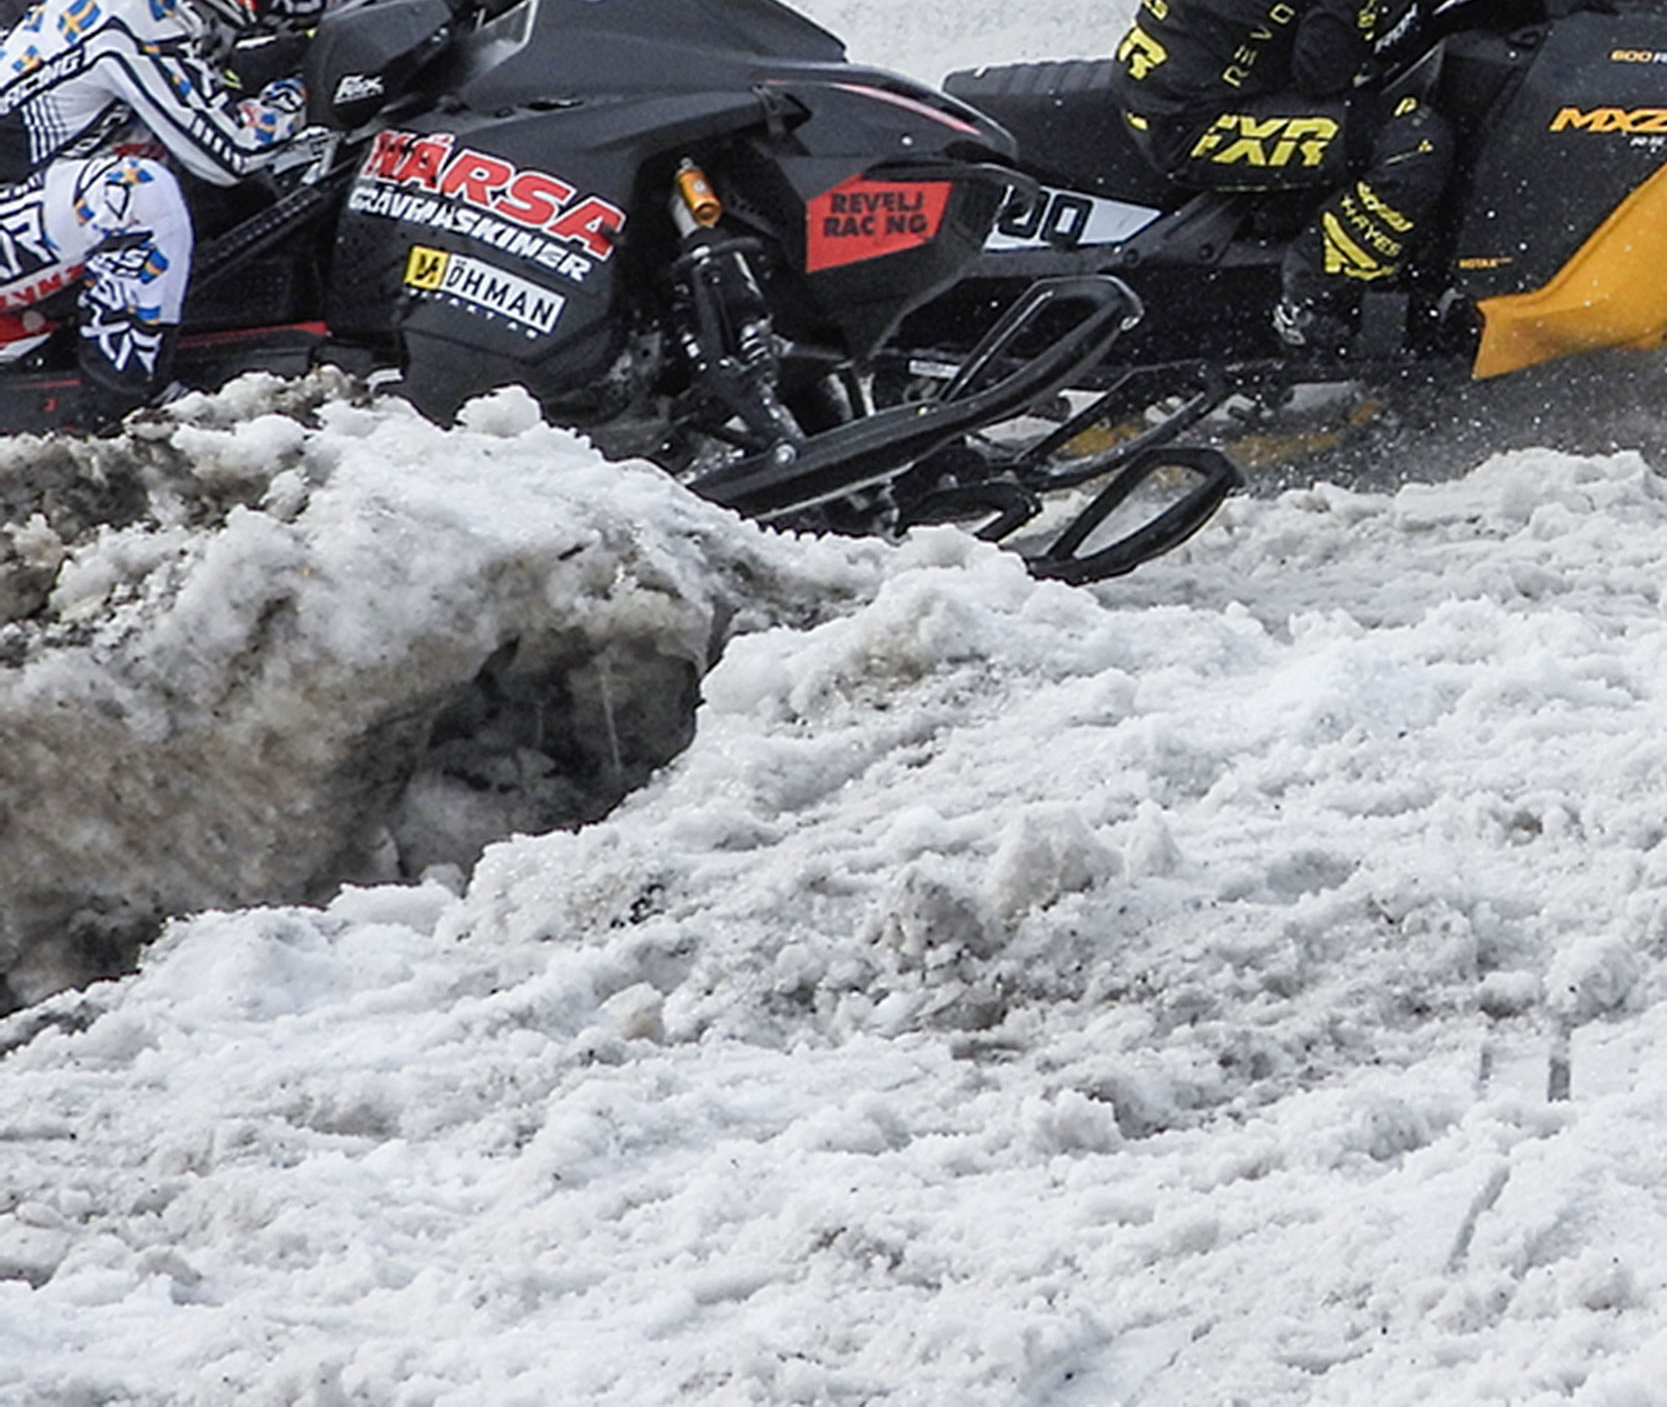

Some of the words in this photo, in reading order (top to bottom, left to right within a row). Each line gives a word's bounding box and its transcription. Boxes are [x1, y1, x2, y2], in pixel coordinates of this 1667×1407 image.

[1222, 2, 1296, 87] REVO
[1190, 113, 1339, 167] FXR
[446, 258, 556, 327] ÖHMAN
